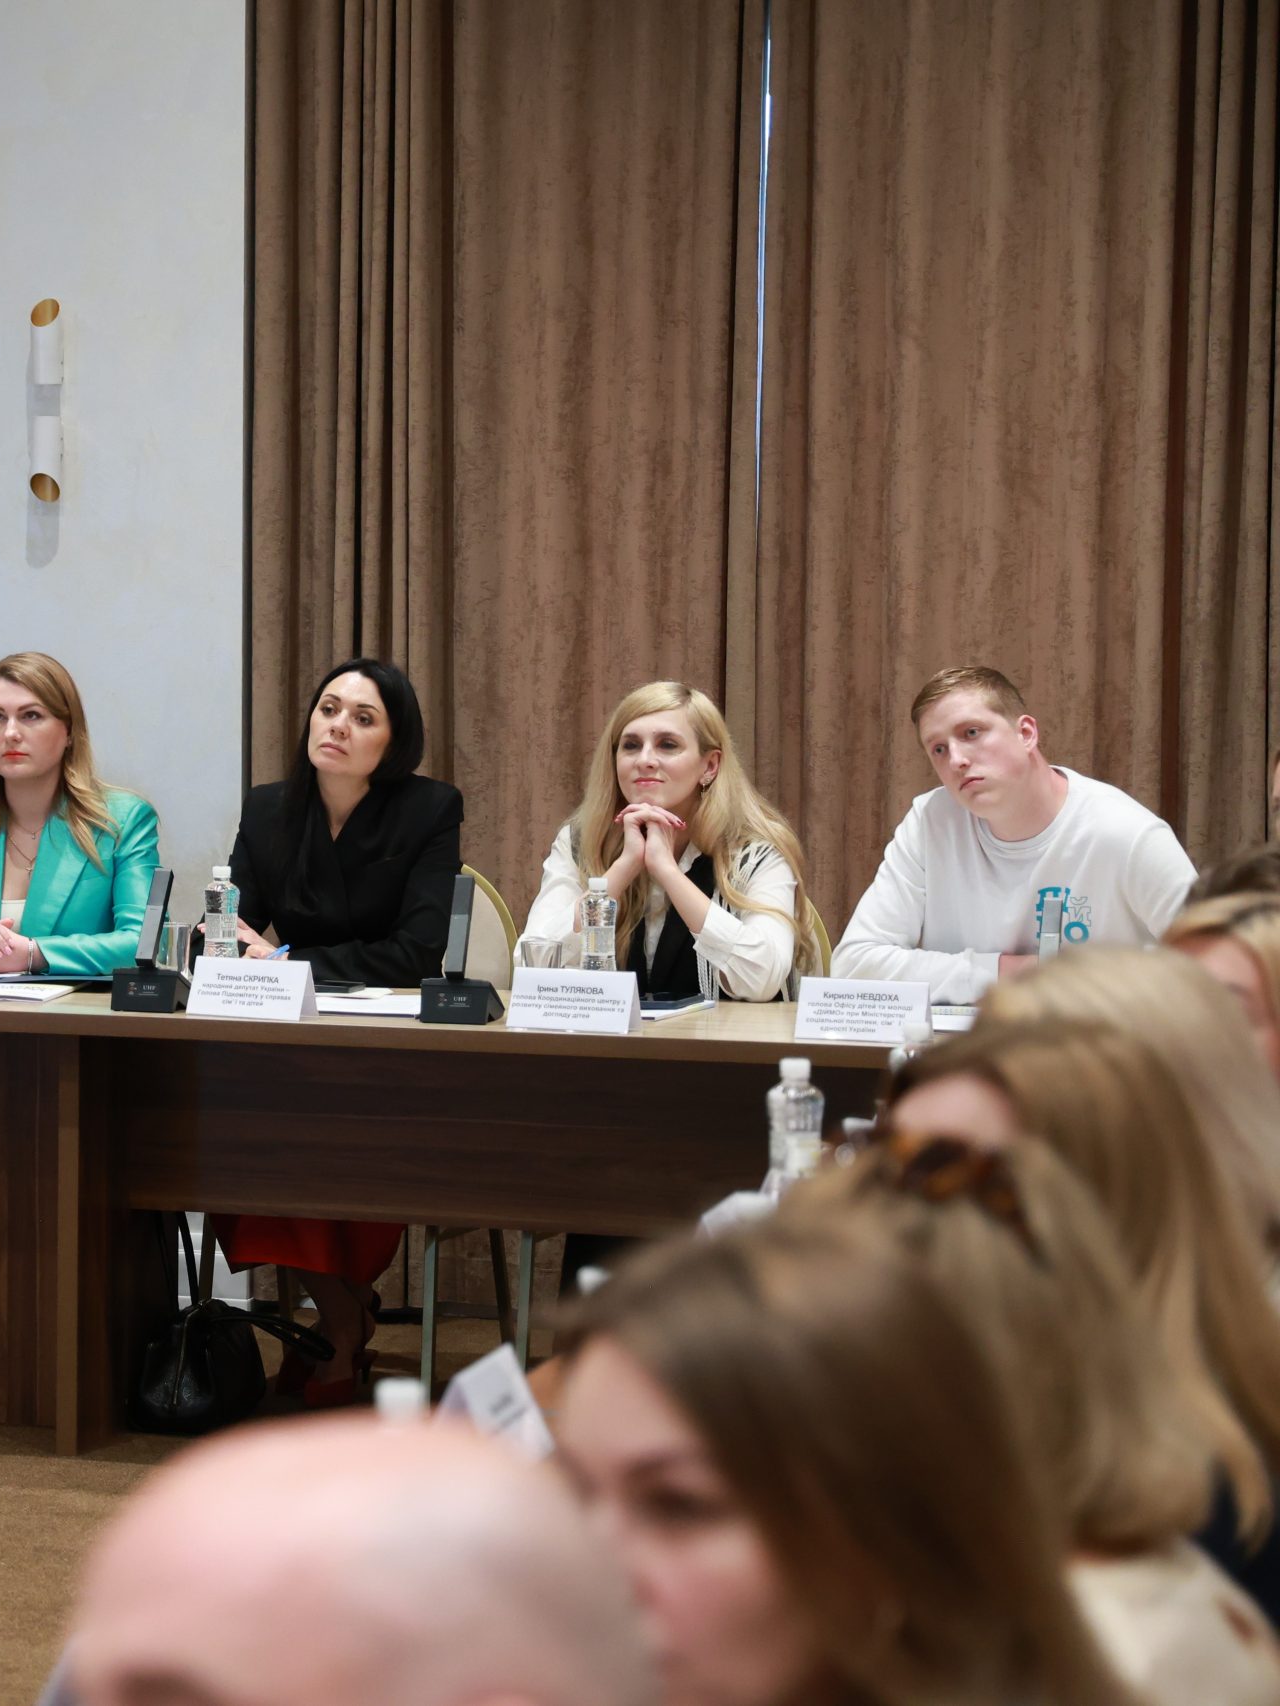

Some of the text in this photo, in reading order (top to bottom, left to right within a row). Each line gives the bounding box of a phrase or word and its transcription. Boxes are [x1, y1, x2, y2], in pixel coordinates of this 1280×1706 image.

[243, 975, 279, 983] СКРИПКА
[538, 985, 604, 995] Ірина ТУЛЯКОВА
[222, 991, 258, 999] Підкомітету
[538, 995, 595, 1003] Координаційного
[824, 992, 899, 1001] Кирило НЕВДОХА
